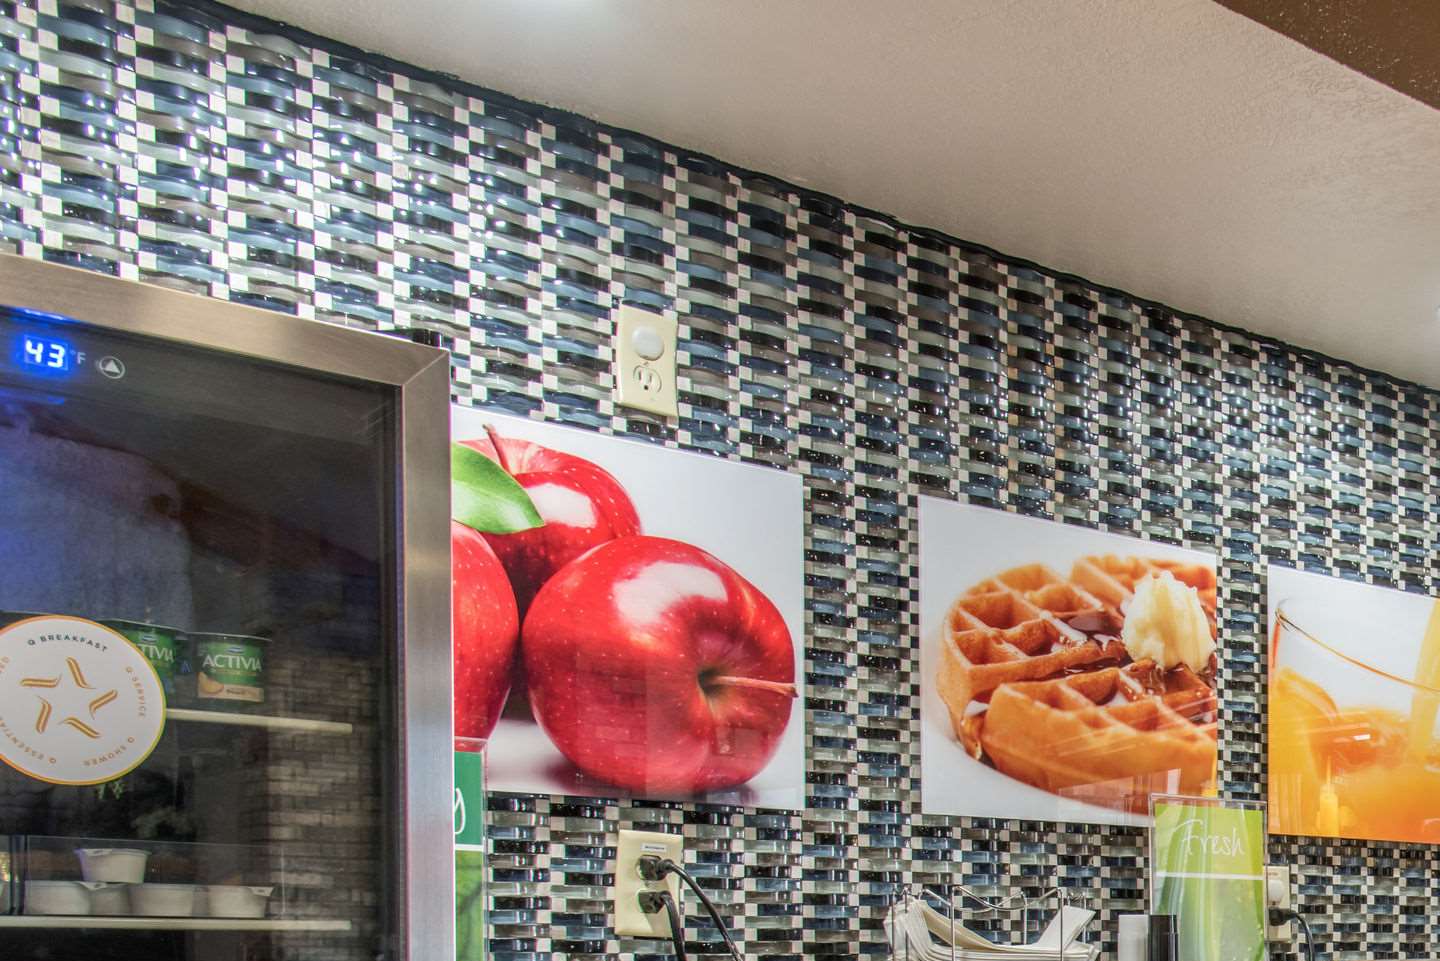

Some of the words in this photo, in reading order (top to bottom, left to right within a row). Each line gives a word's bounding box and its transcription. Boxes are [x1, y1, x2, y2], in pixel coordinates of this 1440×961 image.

[26, 340, 65, 368] 43
[40, 634, 108, 652] BREAKFAST
[202, 654, 262, 672] ACTIVIA
[132, 676, 147, 717] SERVICE
[83, 745, 126, 766] SHOWER
[1175, 818, 1246, 858] Fresh
